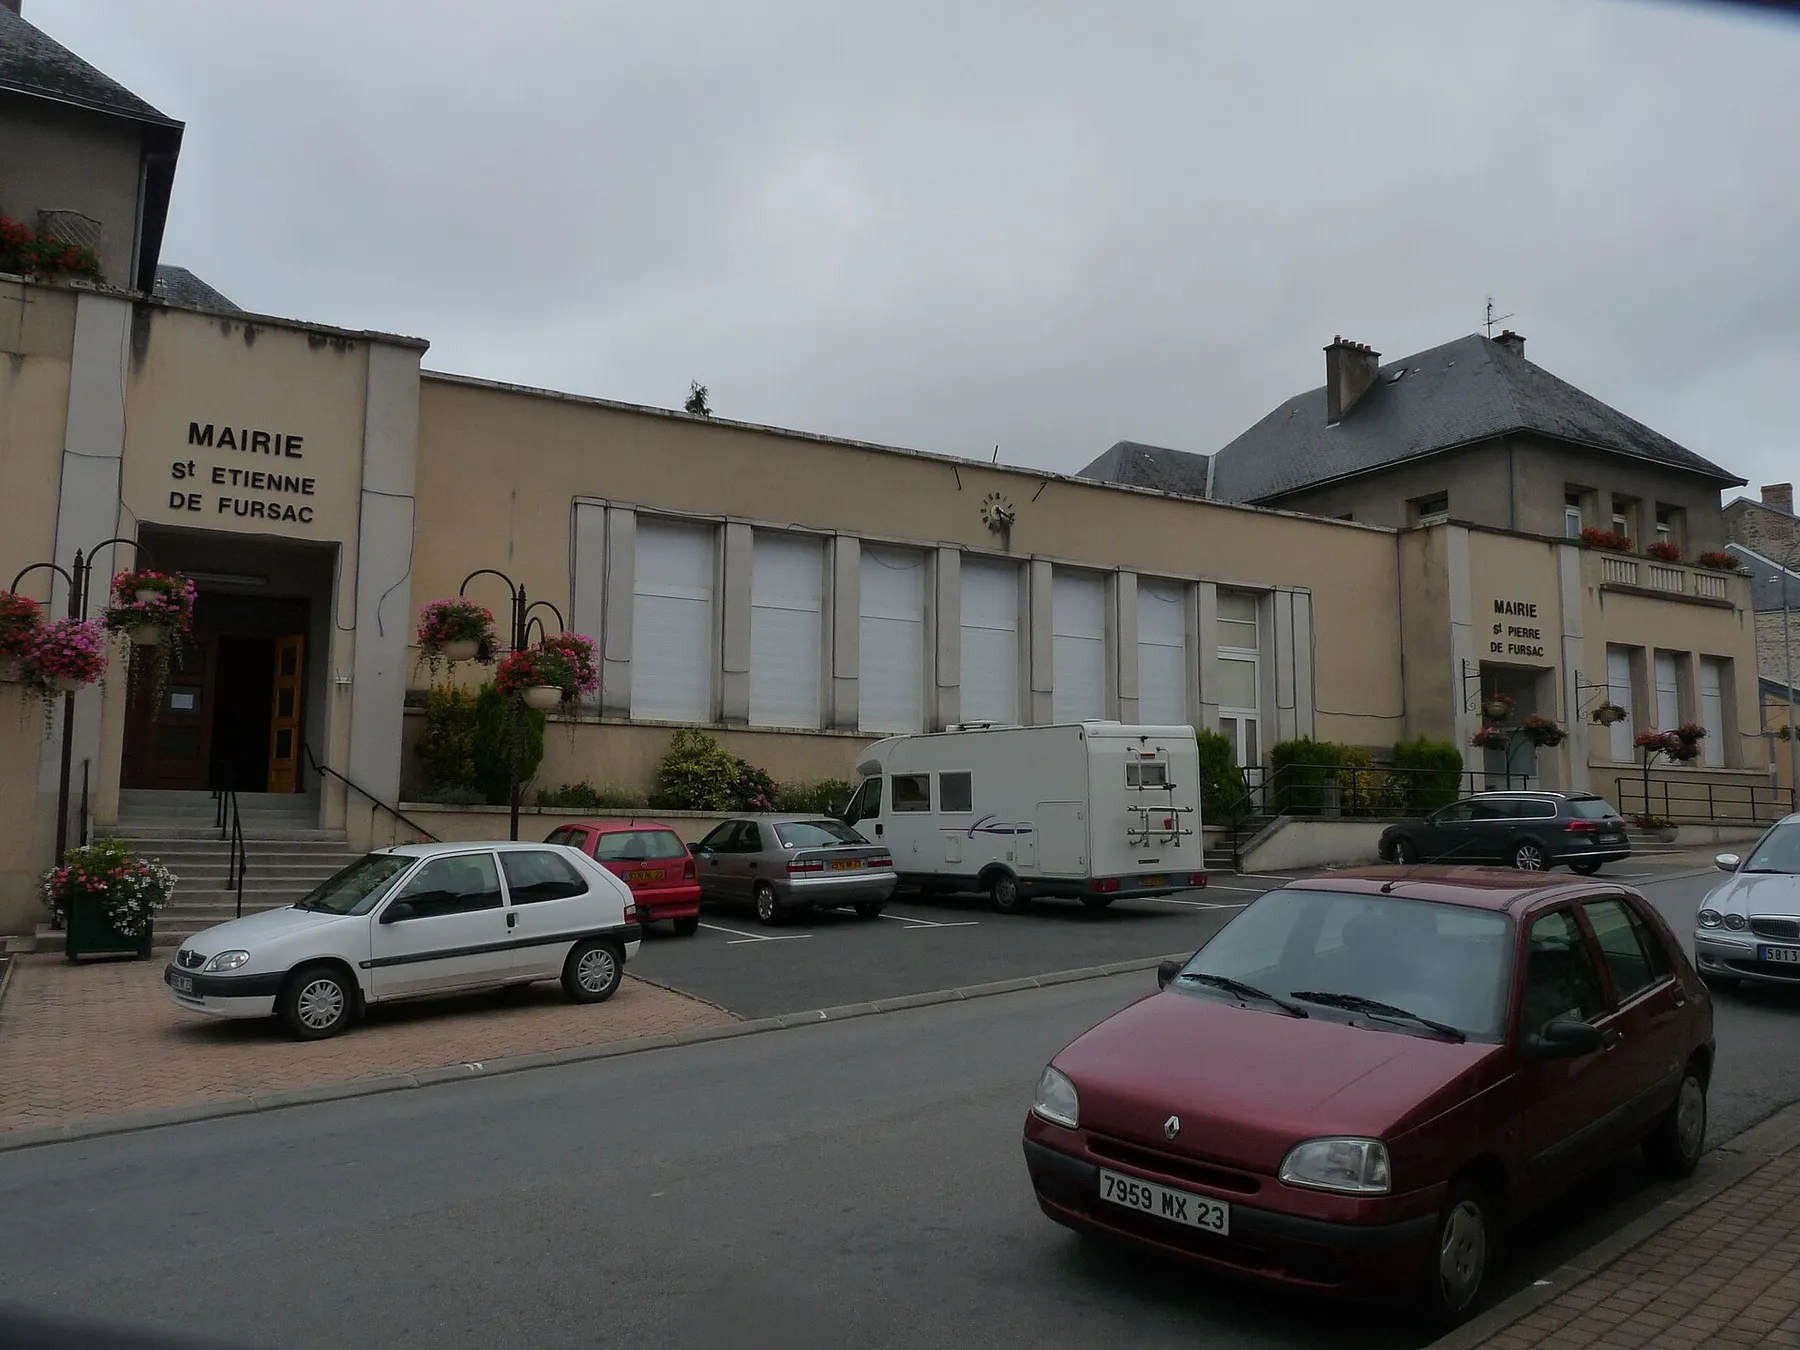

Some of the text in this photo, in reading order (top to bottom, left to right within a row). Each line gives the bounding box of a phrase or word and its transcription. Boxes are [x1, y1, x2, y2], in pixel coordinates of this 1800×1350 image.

[188, 421, 304, 458] MAIRIE
[211, 466, 316, 495] ETIENNE
[169, 491, 314, 523] DE FURSAC
[1494, 599, 1538, 618] MAIRIE
[1508, 625, 1541, 640] PIERRE
[1490, 641, 1544, 657] DE FURSAC
[1768, 949, 1798, 962] 5813
[1104, 1175, 1225, 1230] 7959 MX 23
